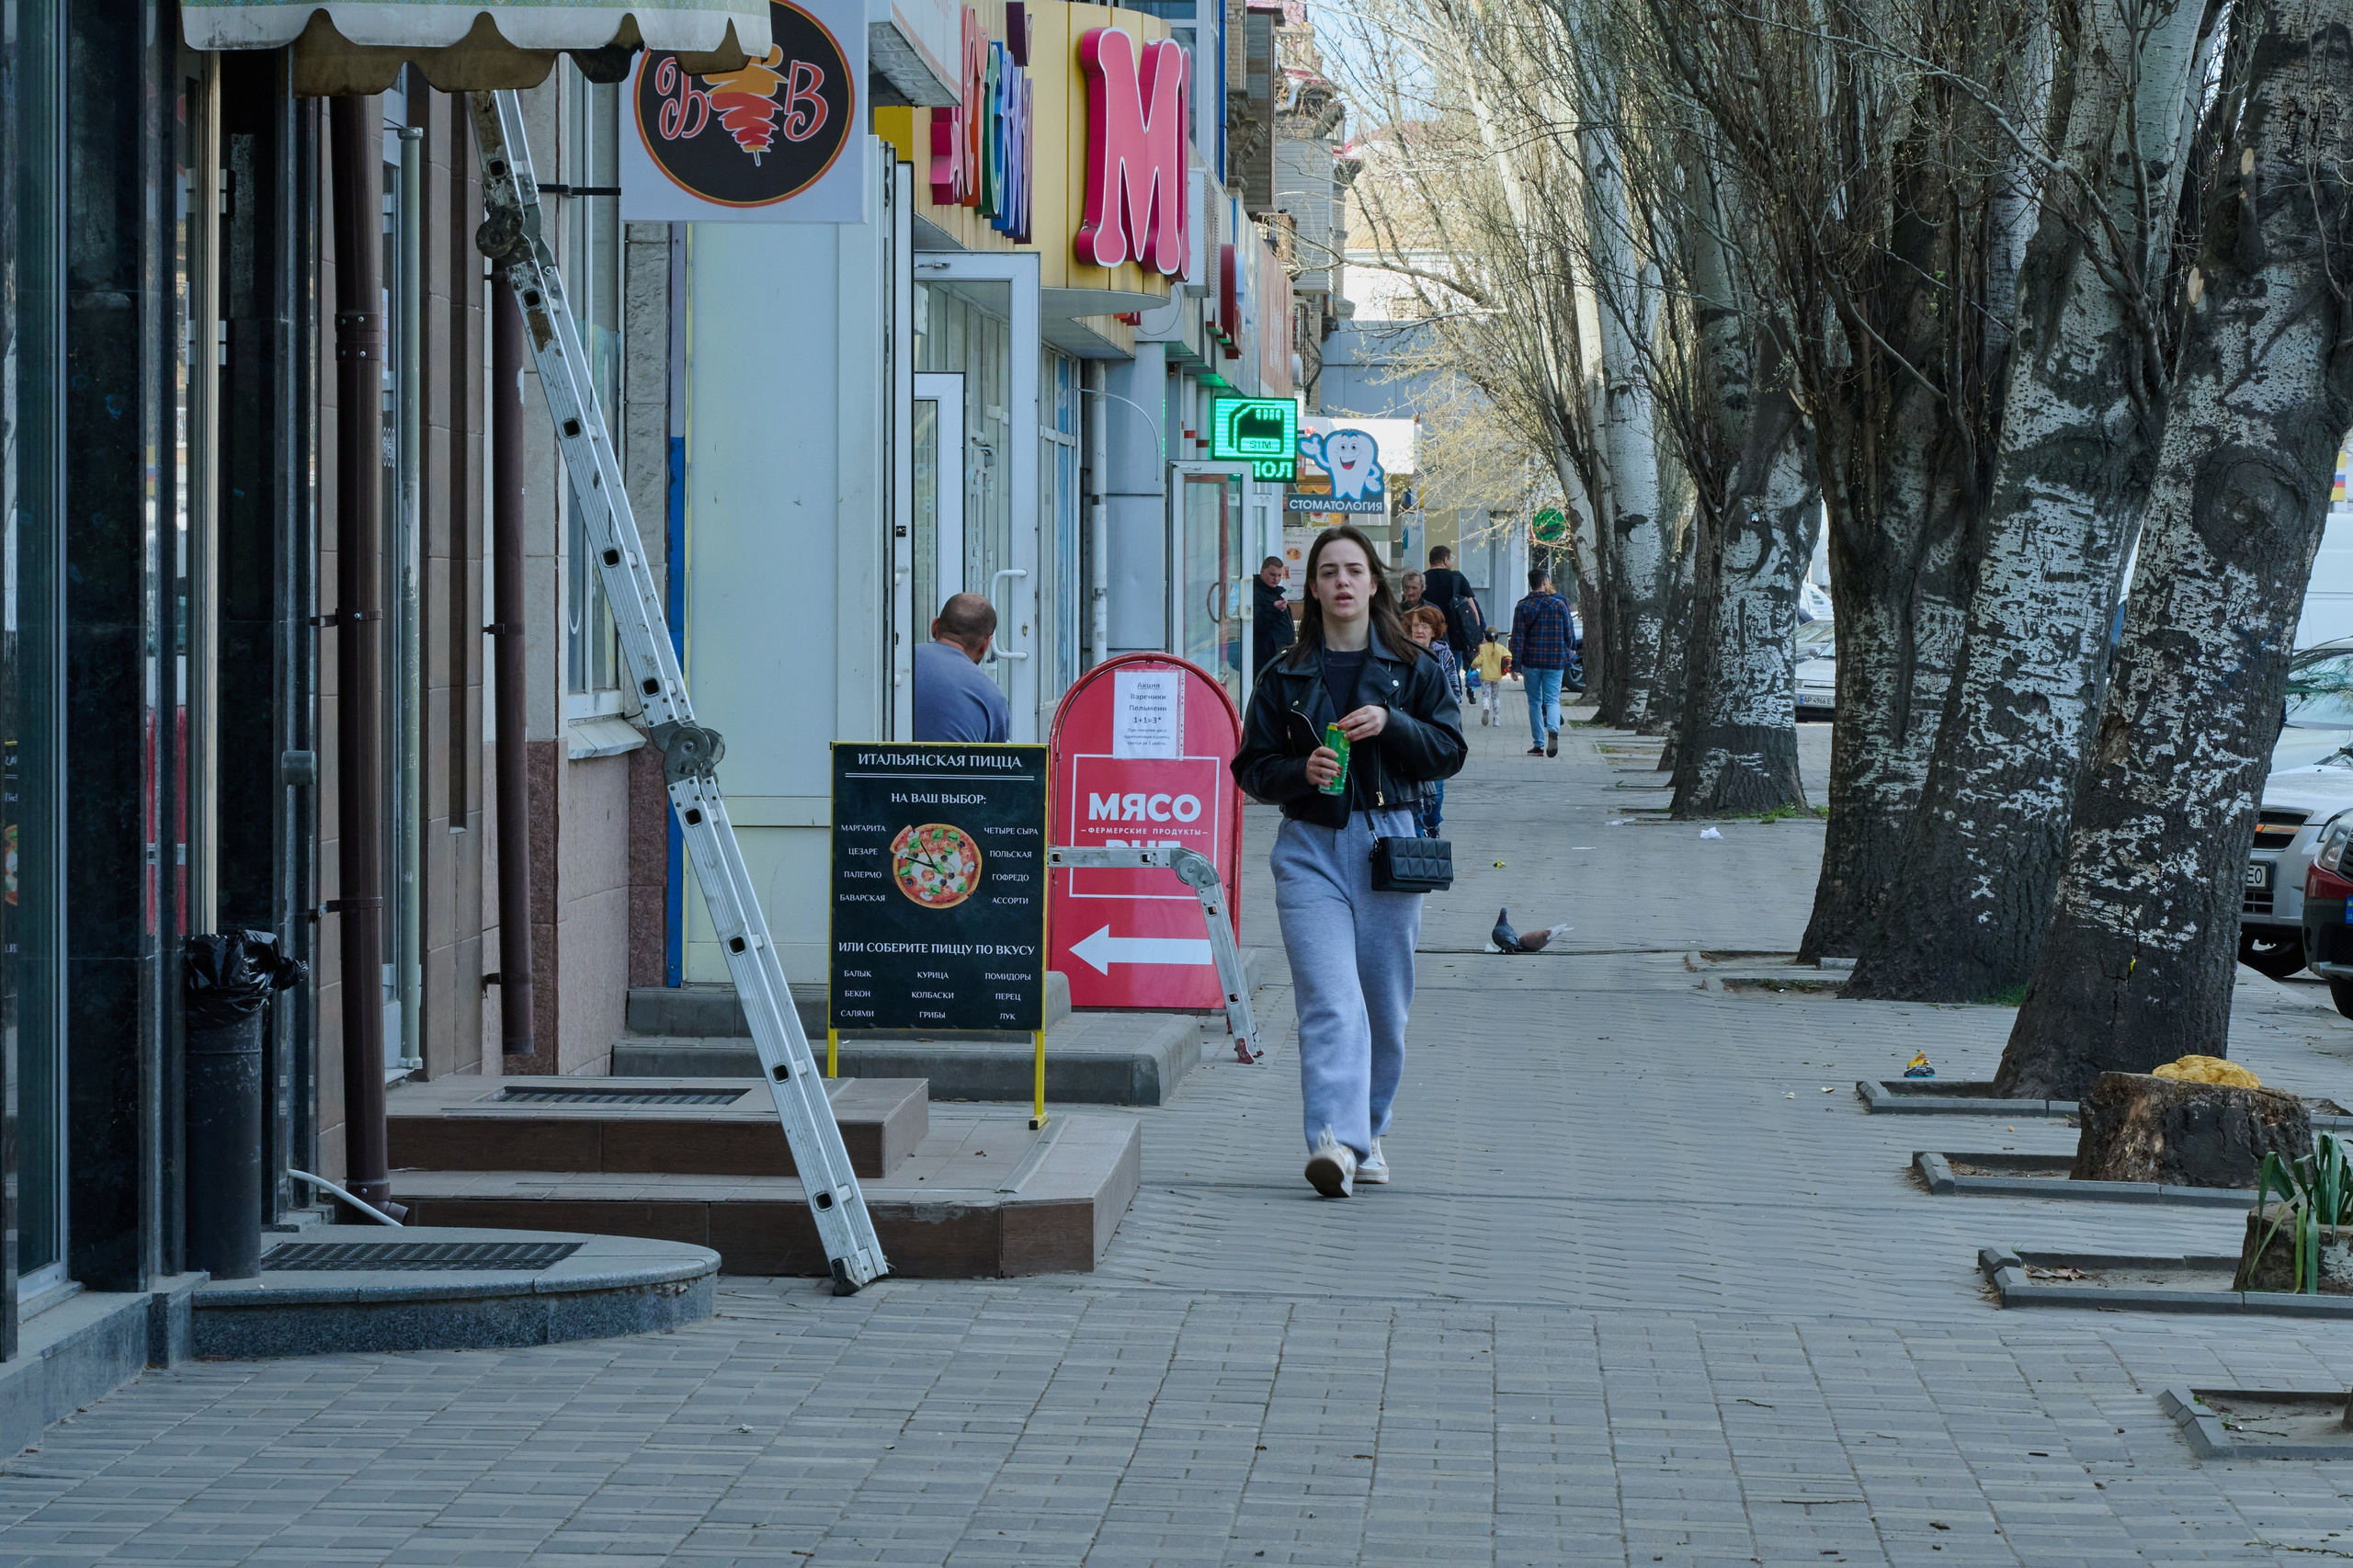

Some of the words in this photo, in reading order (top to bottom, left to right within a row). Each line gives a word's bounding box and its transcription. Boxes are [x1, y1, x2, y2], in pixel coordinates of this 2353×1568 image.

[1289, 498, 1383, 512] СТОМАТОЛОГИЯ
[1130, 693, 1166, 701] Вареники
[858, 753, 966, 767] ИТАЛЬЯНСКАЯ
[969, 755, 1023, 770] ПИЦЦА
[891, 792, 908, 803] НА
[911, 793, 938, 803] ВАШ
[941, 794, 987, 804] ВЫБОР:
[1088, 792, 1202, 823] МЯСО
[840, 824, 887, 833] МАРГАРИТА
[983, 826, 1016, 835] ЧЕТЫРЕ
[1017, 827, 1039, 835] СЫРА
[1087, 827, 1147, 835] ФЕРМЕРСКИЕ
[1152, 828, 1201, 836] ПРОДУКТЫ
[848, 847, 879, 857] ЦЕЗАРЕ
[989, 850, 1032, 858] ПОЛЬСКАЯ
[844, 871, 882, 880] ПАЛЕРМО
[992, 873, 1029, 882] ГОФРЕДО
[839, 893, 886, 903] БАВАРСКАЯ
[992, 896, 1029, 904] АССОРТИ
[838, 942, 864, 952] ИЛИ
[867, 942, 928, 953] СОБЕРИТЕ
[931, 944, 973, 956] ПИЦЦУ
[976, 944, 994, 955] ПО
[996, 945, 1036, 956] ВКУСУ
[844, 970, 872, 978] БАЛЫК
[916, 971, 949, 980] КУРИЦА
[984, 972, 1031, 982] ПОМИДОРЫ
[844, 990, 871, 998] БЕКОН
[911, 991, 955, 999] КОЛБАСКИ
[995, 993, 1021, 1002] ПЕРЕЦ
[840, 1009, 874, 1017] САЛЯМИ
[919, 1011, 946, 1019] ГРИБЫ
[999, 1012, 1017, 1020] ЛУК
